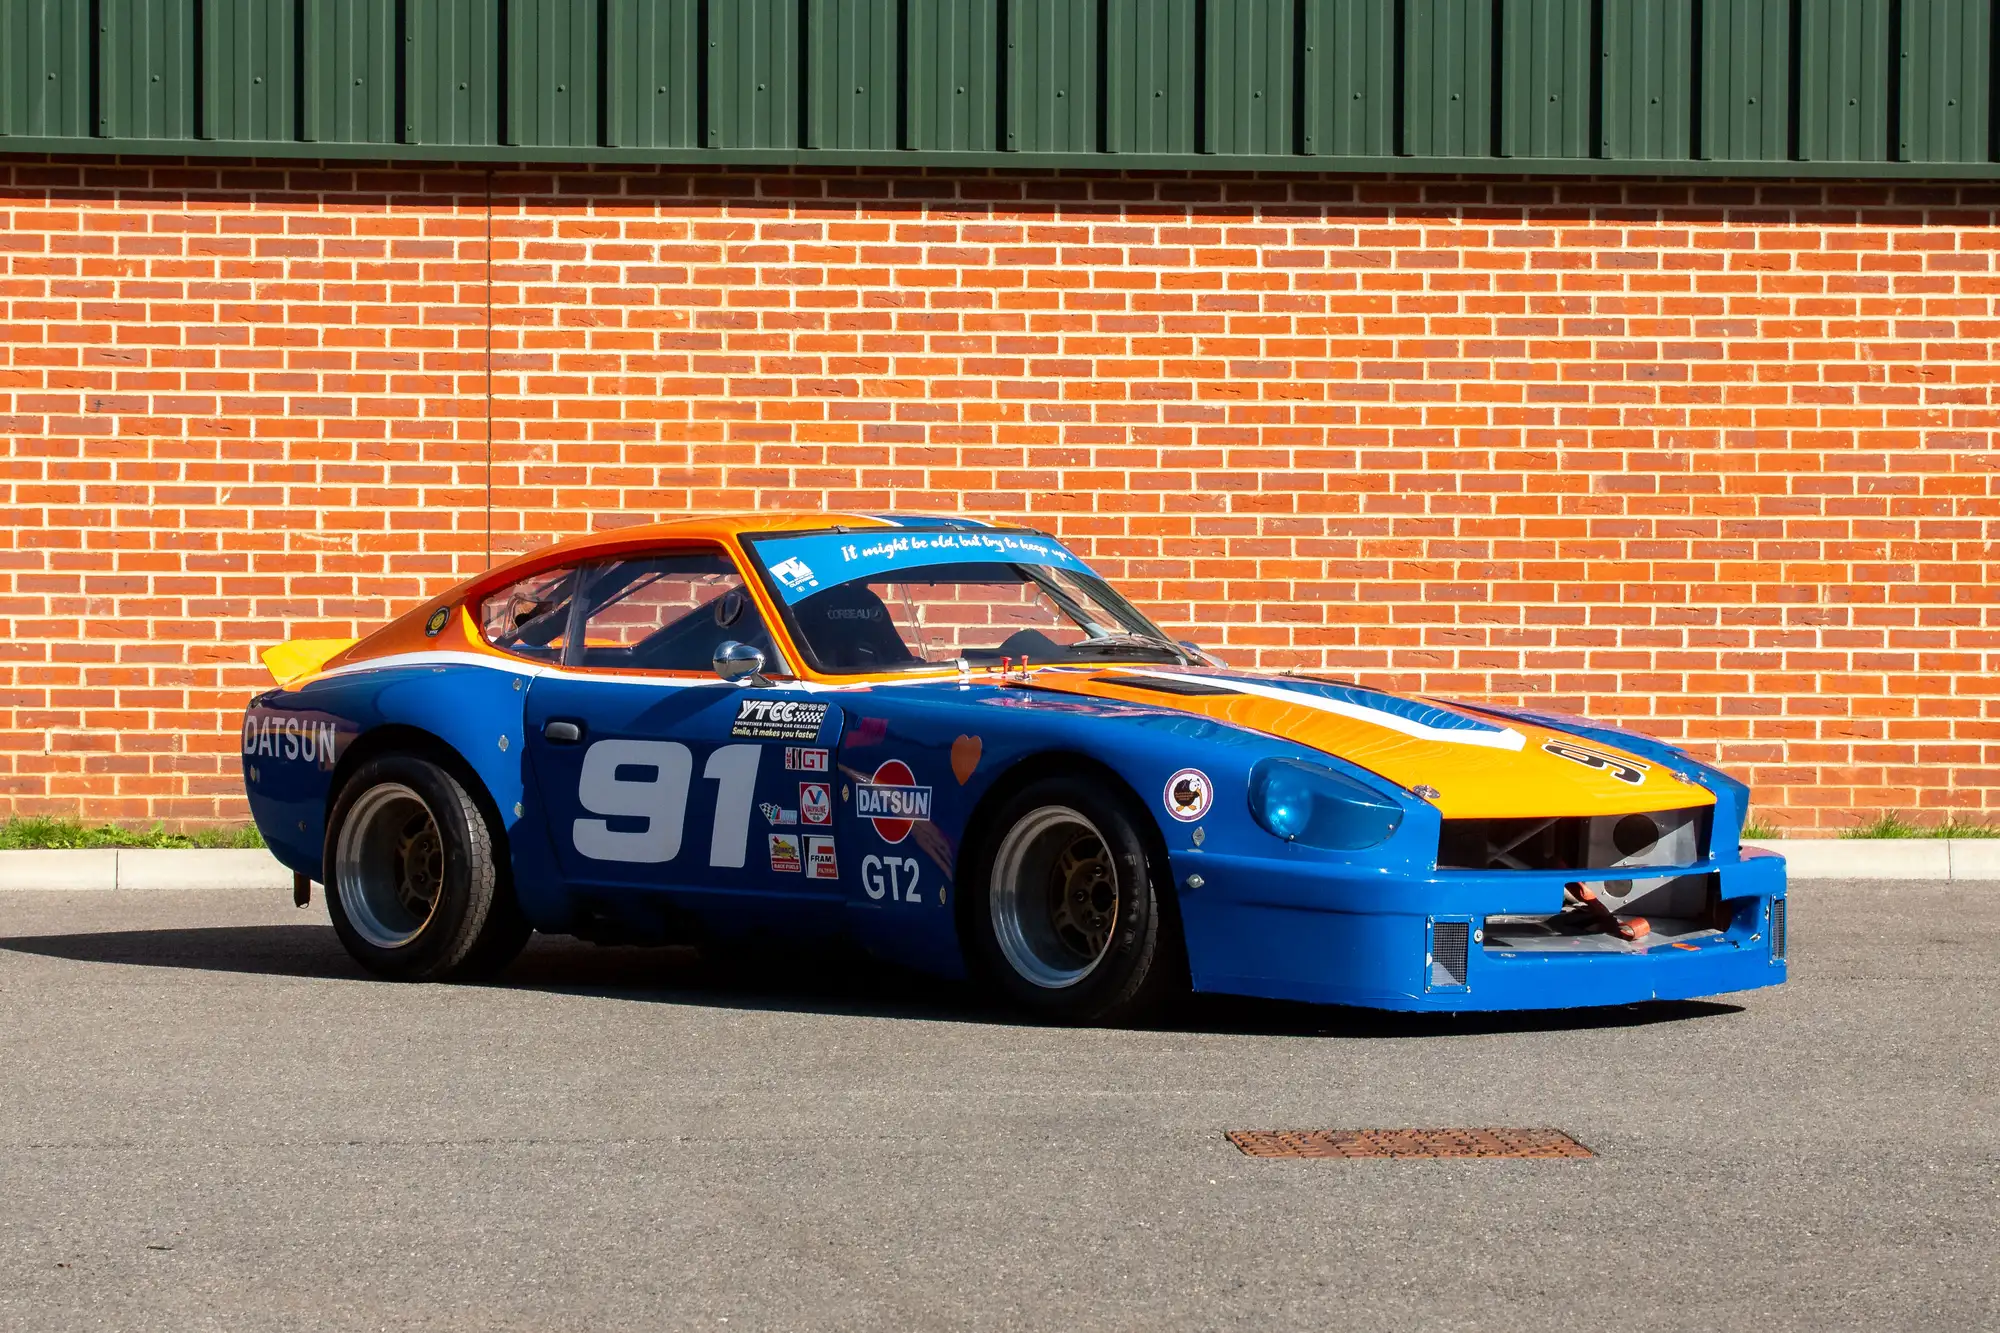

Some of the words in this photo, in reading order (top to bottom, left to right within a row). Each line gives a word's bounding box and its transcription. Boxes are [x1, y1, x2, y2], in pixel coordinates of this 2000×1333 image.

[841, 544, 858, 562] It
[862, 537, 909, 559] might
[911, 537, 929, 549] be
[959, 534, 982, 548] but
[981, 535, 1005, 552] try
[1004, 537, 1019, 549] to
[1019, 539, 1048, 557] keep
[827, 607, 871, 620] CORBEAU
[737, 700, 799, 722] YTCC
[243, 715, 336, 764] DATSUN
[732, 726, 752, 737] Smile,
[752, 728, 759, 736] it
[758, 728, 780, 737] makes
[780, 731, 795, 739] you
[794, 729, 817, 739] faster
[803, 751, 828, 769] GT
[572, 739, 763, 868] 91
[858, 789, 929, 815] DATSUN
[810, 854, 832, 863] FRAM
[861, 854, 922, 903] GT2
